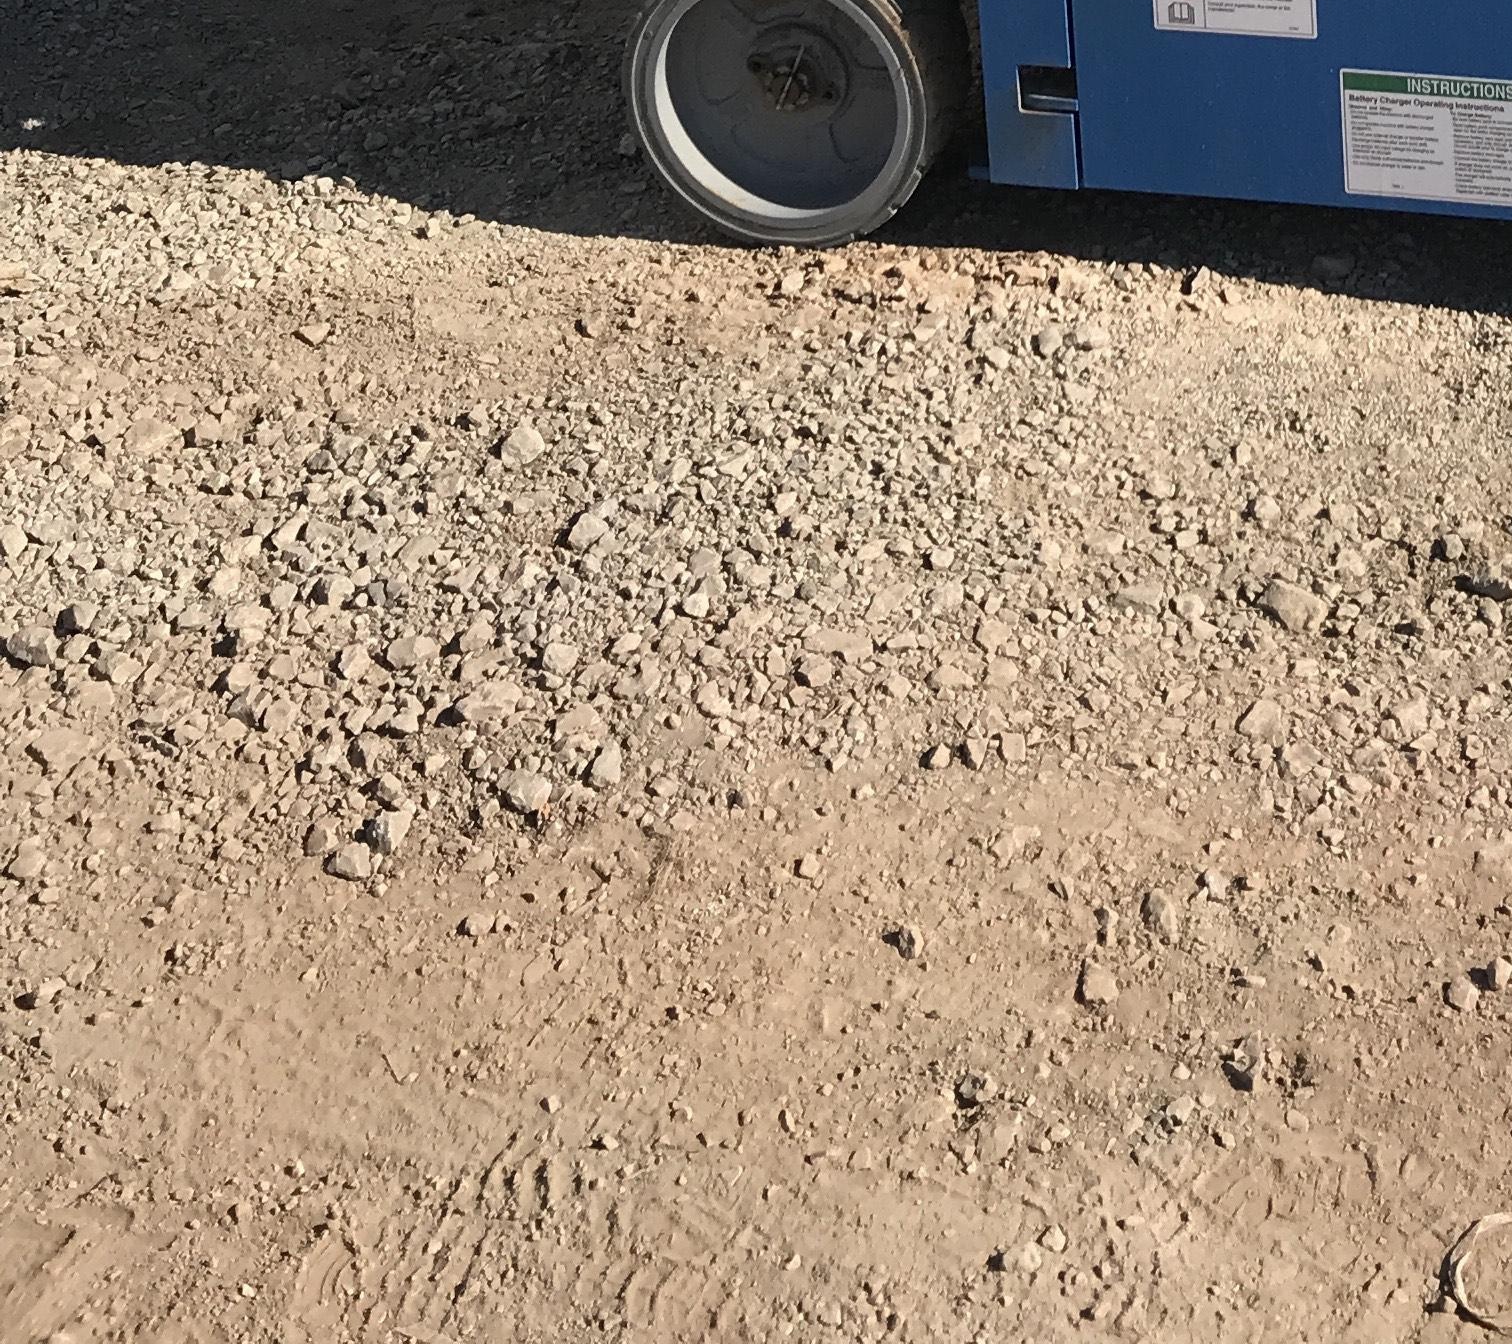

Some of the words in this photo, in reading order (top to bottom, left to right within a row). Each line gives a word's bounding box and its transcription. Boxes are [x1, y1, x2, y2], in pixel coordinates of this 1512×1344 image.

[1349, 94, 1378, 104] Battery
[1379, 95, 1412, 106] Charger
[1413, 98, 1454, 110] Operating
[1455, 102, 1505, 112] Instructions
